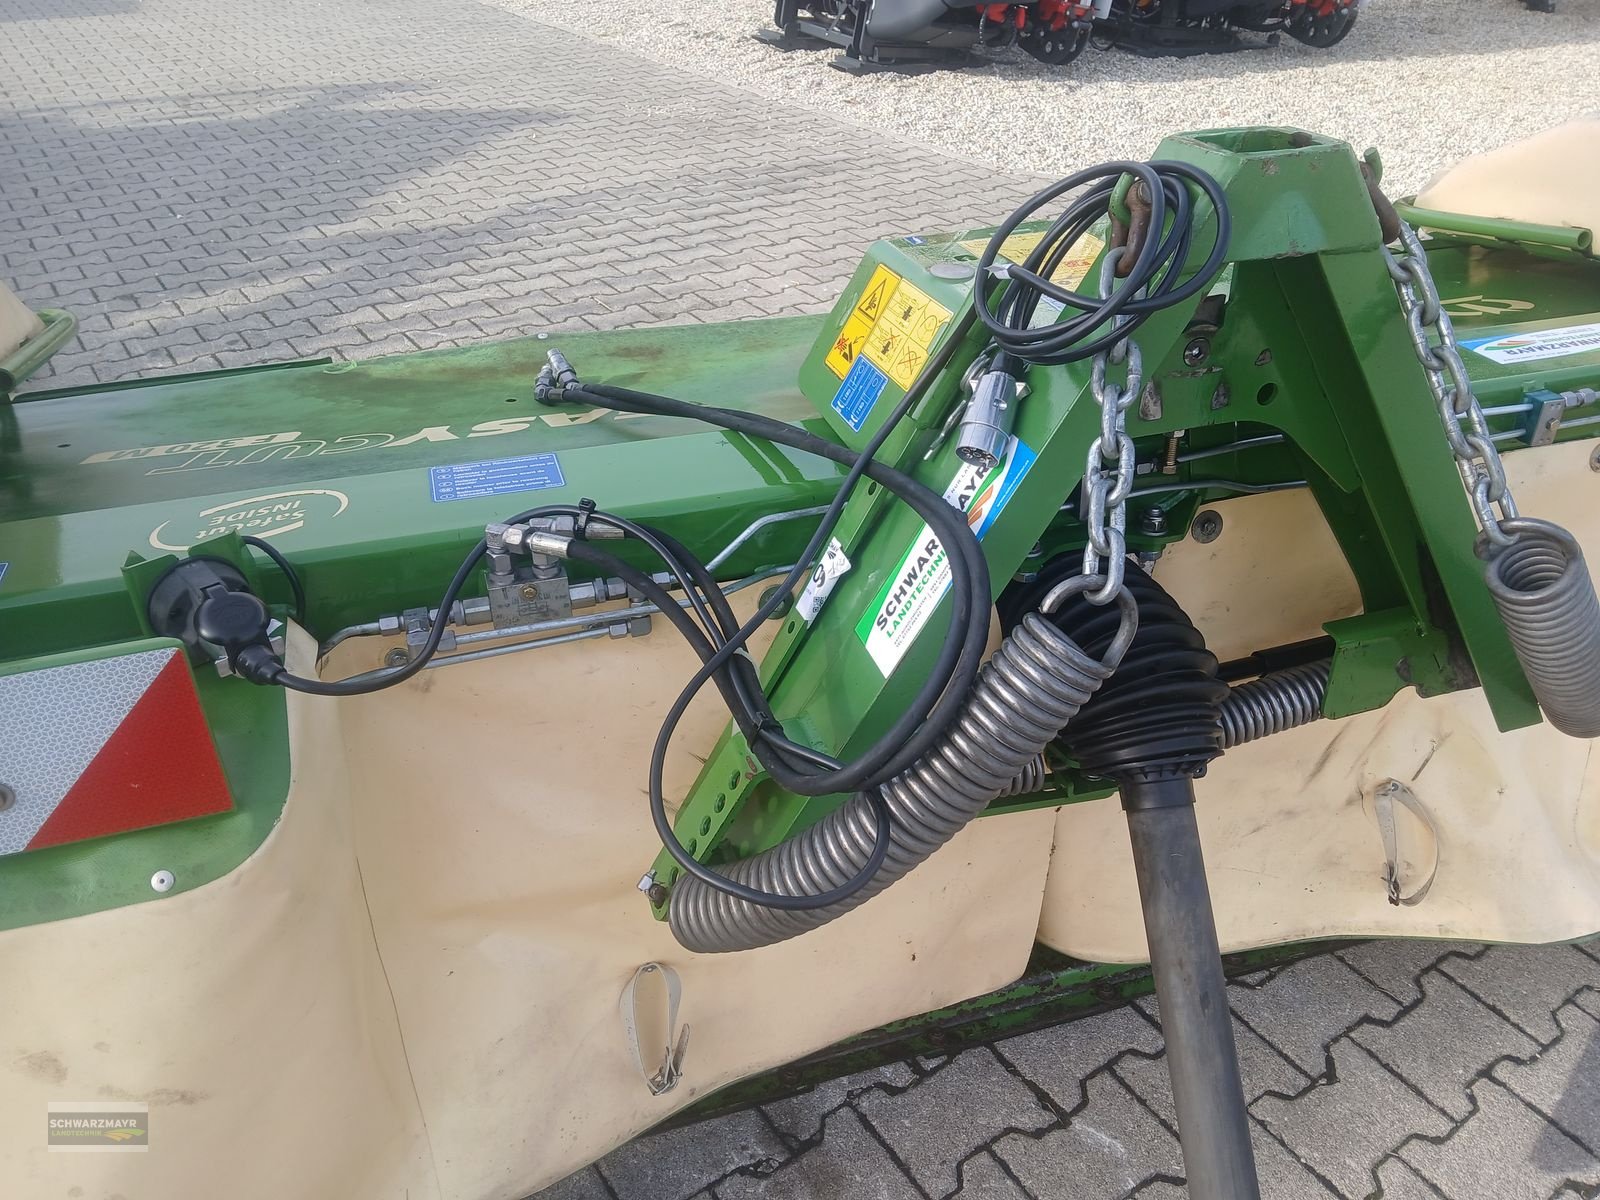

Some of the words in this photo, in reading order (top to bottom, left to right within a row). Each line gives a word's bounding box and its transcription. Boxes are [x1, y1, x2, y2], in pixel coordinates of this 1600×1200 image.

[145, 407, 656, 476] ASYCUT
[208, 500, 302, 526] INSIDE
[886, 550, 947, 639] LANDTECHNI
